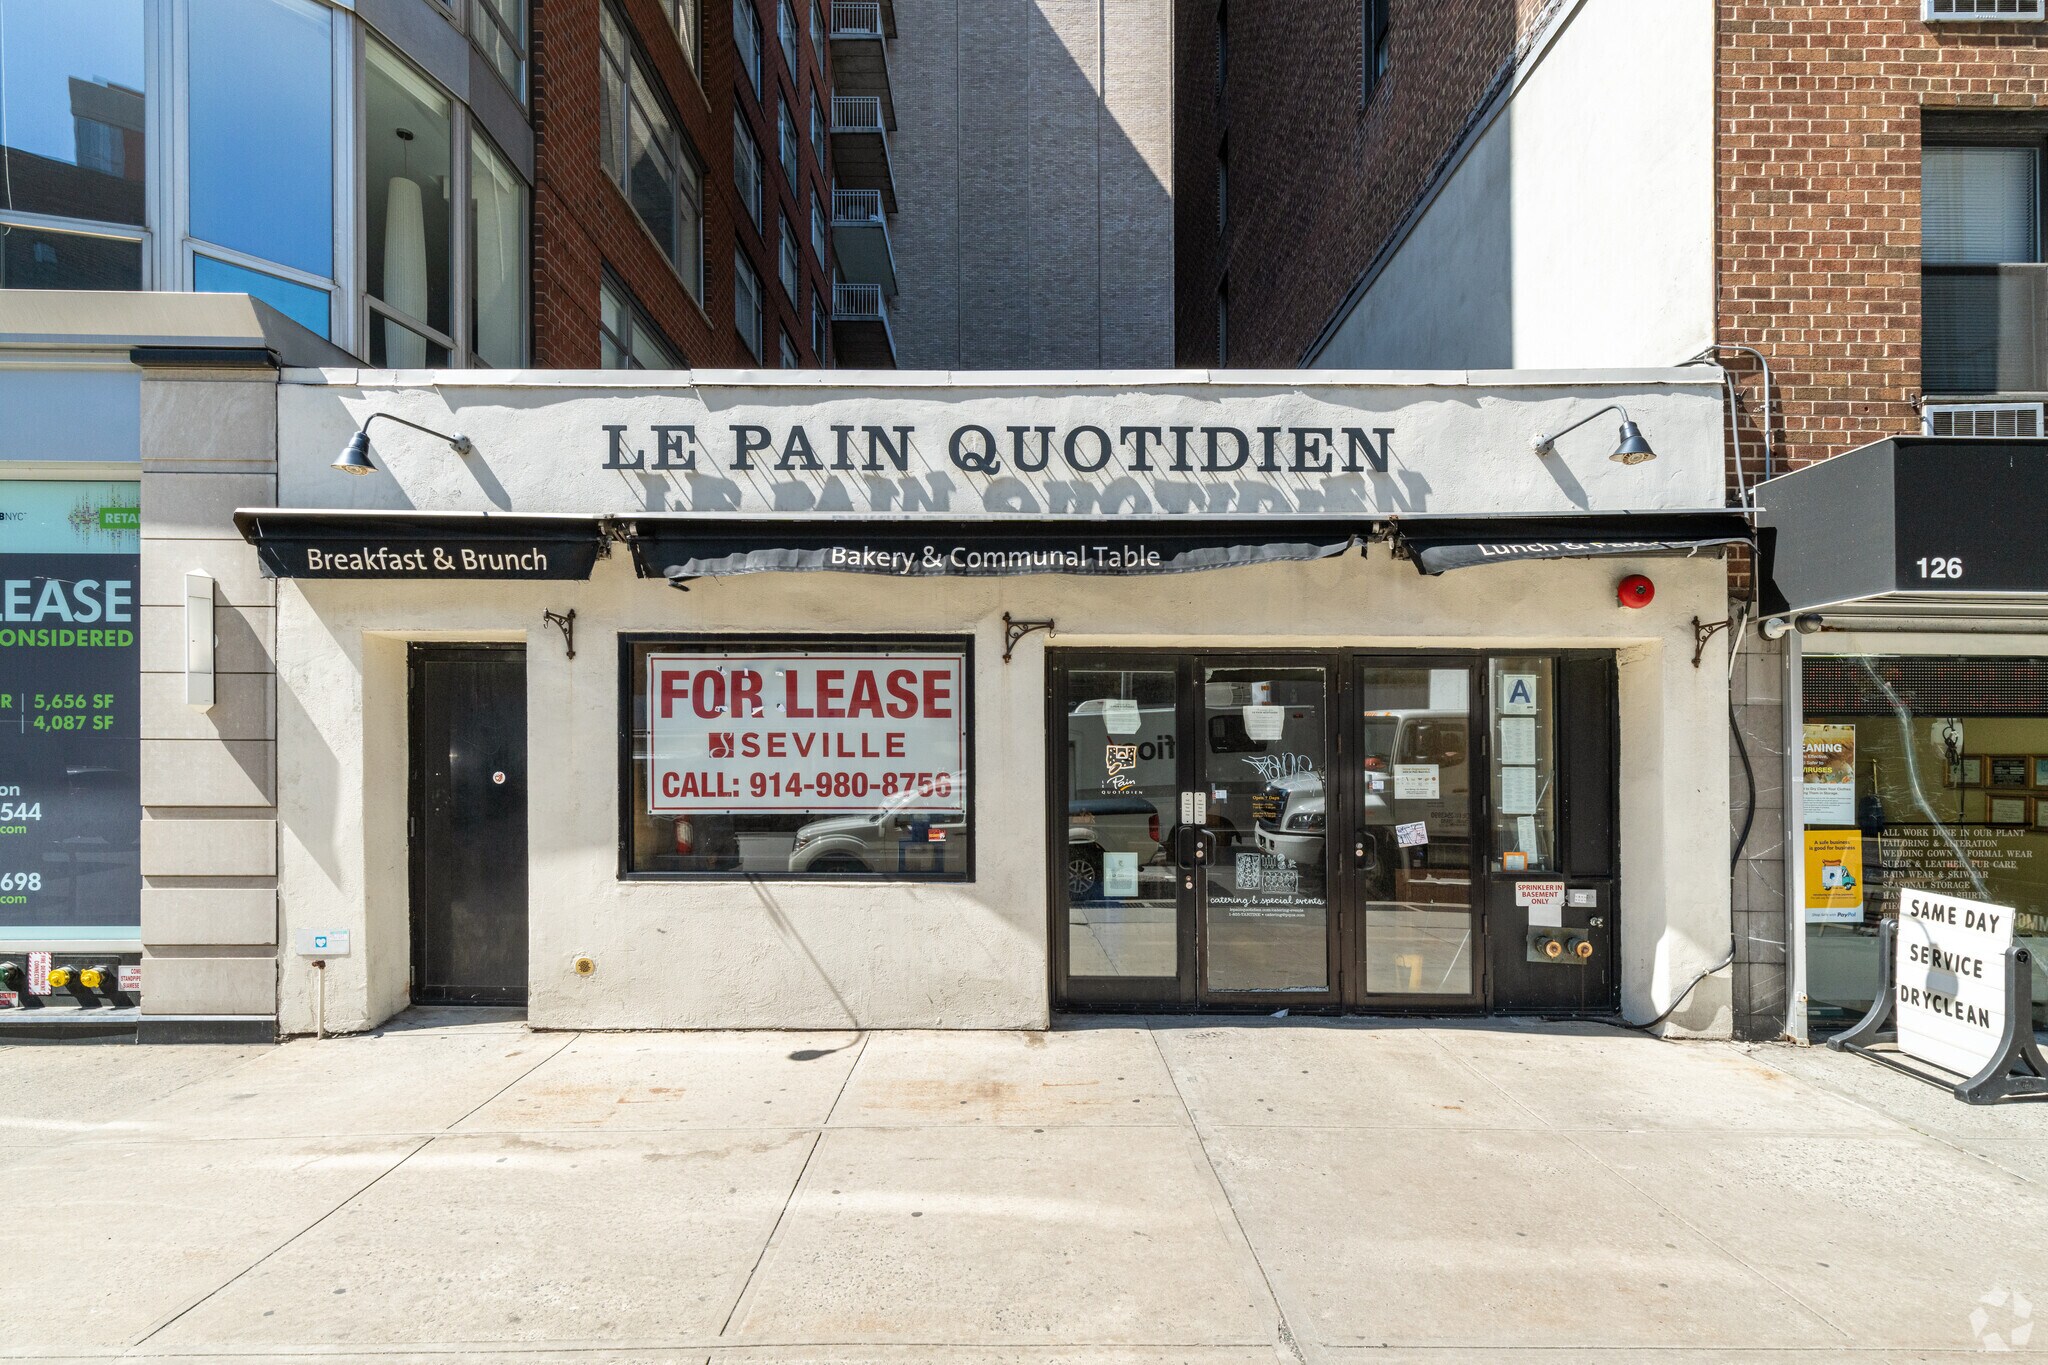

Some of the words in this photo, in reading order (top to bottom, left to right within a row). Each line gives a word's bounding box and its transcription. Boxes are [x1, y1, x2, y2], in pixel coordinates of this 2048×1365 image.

[602, 425, 696, 471] LE
[729, 425, 915, 471] PAIN
[948, 425, 1395, 474] QUOTIDIEN
[307, 546, 426, 570] Breakfast
[433, 547, 455, 570] &
[462, 547, 547, 571] Brunch
[831, 545, 915, 574] Bakery
[922, 546, 943, 568] &
[951, 545, 1085, 568] Communal
[1093, 546, 1160, 568] Table
[1477, 542, 1558, 556] Lunch
[1917, 557, 1963, 578] 126
[0, 579, 131, 622] EASE
[34, 693, 86, 710] 5,656
[92, 693, 114, 709] SF
[660, 669, 764, 719] FOR
[785, 669, 952, 719] LEASE
[1509, 679, 1531, 703] A
[33, 715, 86, 731] 4,087
[92, 715, 114, 730] SF
[741, 732, 906, 758] SEVILLE
[662, 772, 739, 798] CALL:
[751, 771, 952, 798] 914-980-8756
[1107, 774, 1135, 789] Pain
[0, 803, 42, 821] 544
[1882, 828, 1900, 836] ALL
[1903, 828, 1929, 836] WORK
[1996, 829, 2025, 837] PLANT
[1967, 850, 2003, 858] FORMAL
[2007, 850, 2033, 858] WEAR
[0, 872, 41, 891] 698
[1931, 881, 1970, 889] STORAGE
[1210, 896, 1251, 907] catering
[1260, 895, 1293, 906] special
[1294, 897, 1325, 905] events
[1910, 899, 1956, 925] SAME
[1965, 909, 2000, 933] DAY
[1910, 944, 1983, 978] SERVICE
[1901, 985, 1990, 1029] DRYCLEAN
